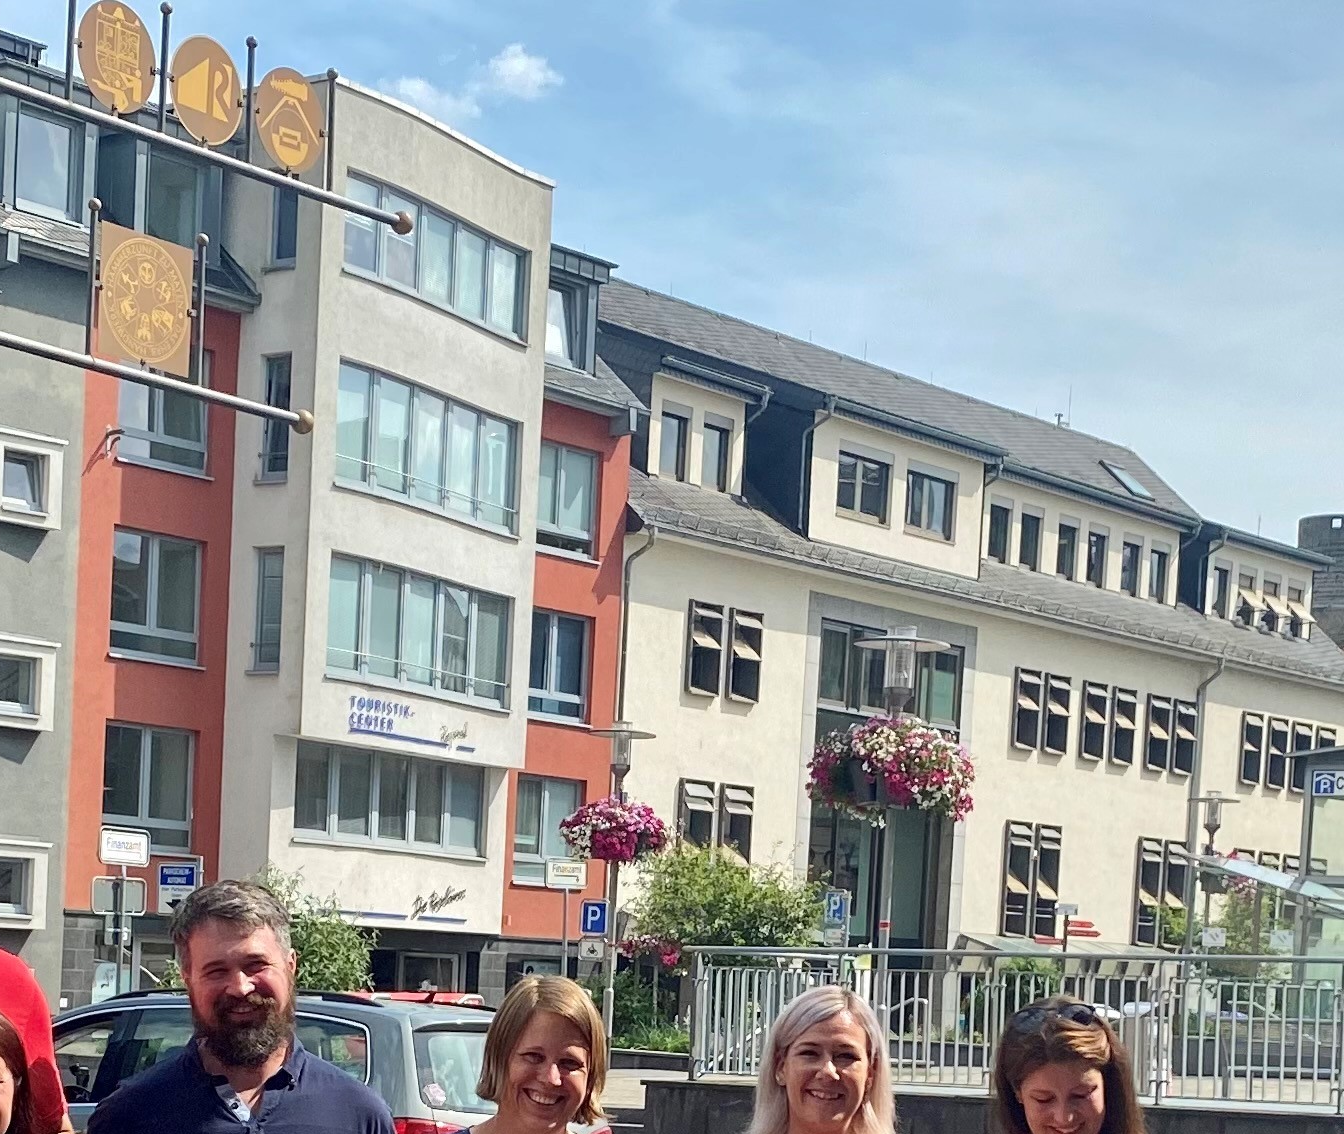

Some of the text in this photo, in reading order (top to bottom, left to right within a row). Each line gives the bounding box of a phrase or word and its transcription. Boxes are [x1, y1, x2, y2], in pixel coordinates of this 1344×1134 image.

[349, 695, 416, 719] TOURISTIK-
[348, 711, 394, 732] CENTER
[106, 836, 142, 851] Finanzamt
[552, 863, 582, 874] Finanzamt
[587, 905, 601, 930] P
[829, 895, 841, 919] P
